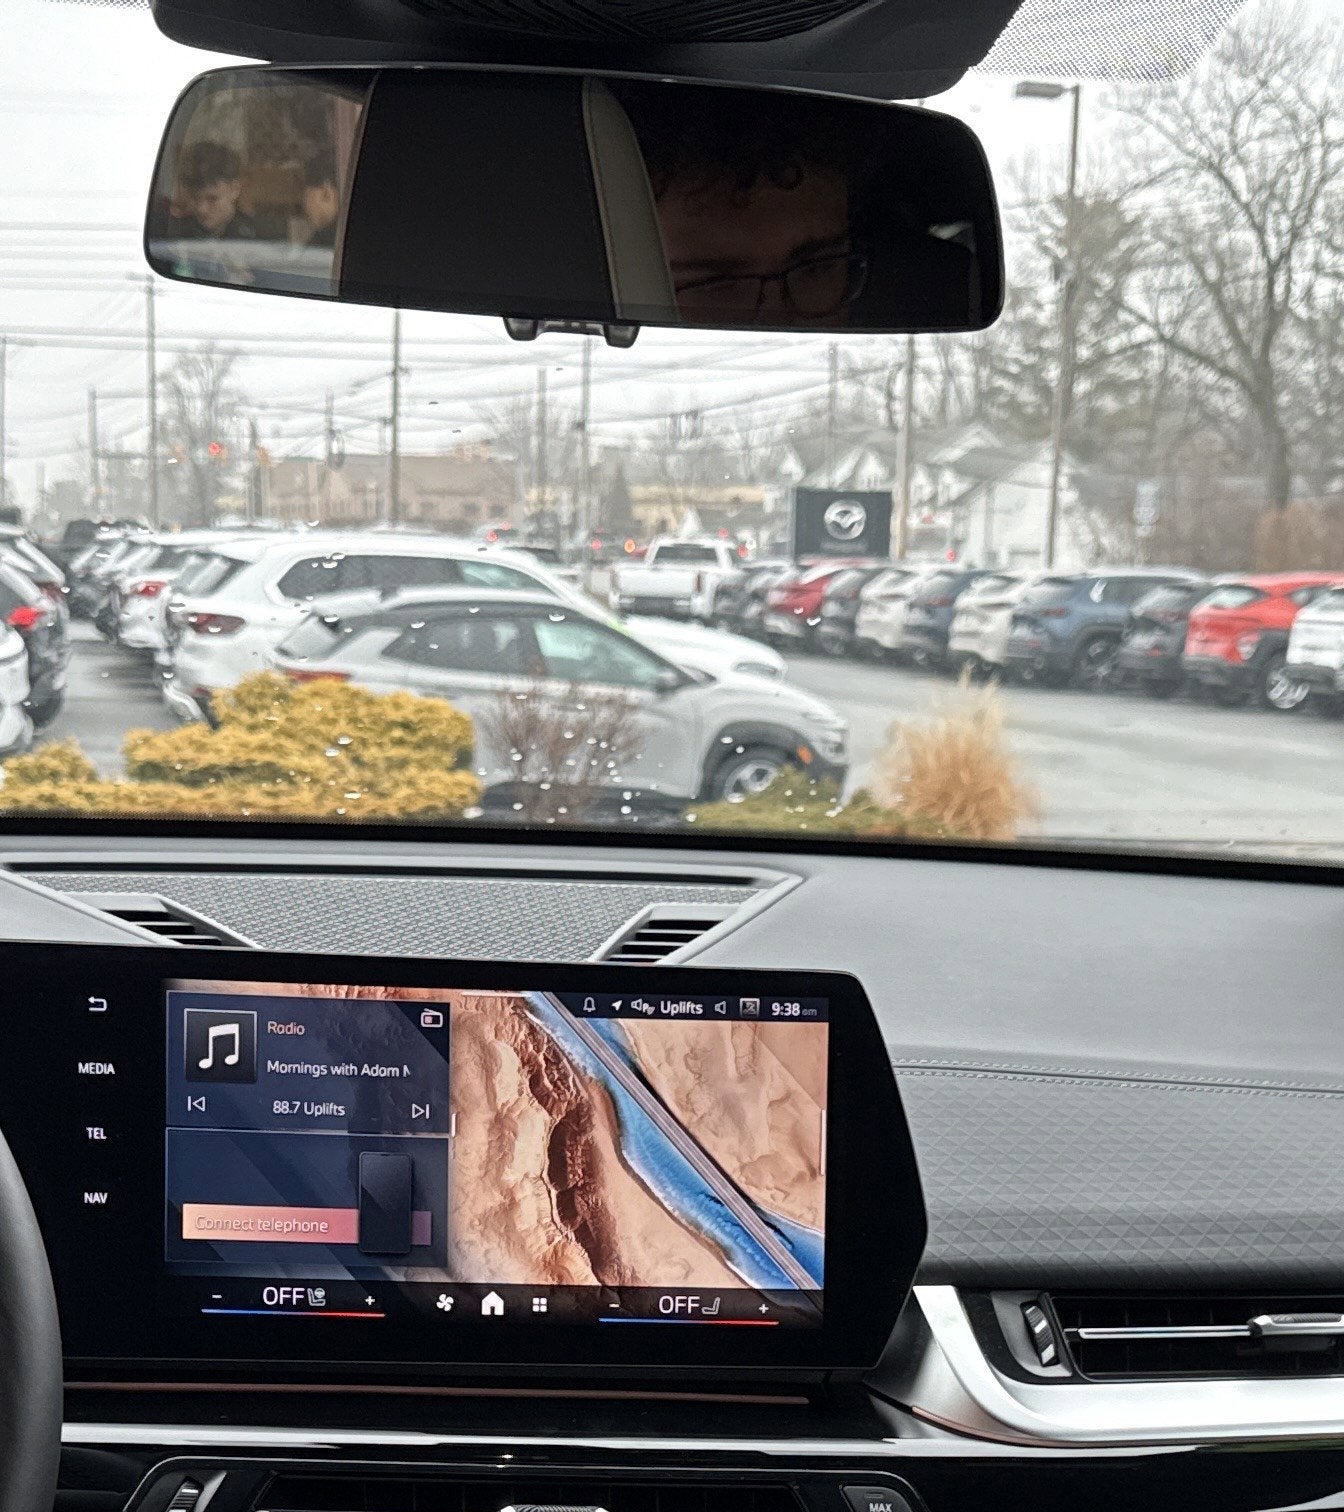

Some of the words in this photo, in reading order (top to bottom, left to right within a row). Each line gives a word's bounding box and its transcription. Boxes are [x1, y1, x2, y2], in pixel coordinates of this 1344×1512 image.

[660, 1000, 703, 1016] Uplifts
[771, 1002, 800, 1016] 9:38
[267, 1021, 305, 1036] Radio
[78, 1062, 115, 1074] MEDIA
[267, 1060, 328, 1078] Mornings
[331, 1062, 357, 1077] with
[360, 1064, 400, 1078] Adam
[273, 1101, 301, 1115] 88.7
[304, 1102, 345, 1117] Uplifts
[86, 1127, 107, 1139] TEL
[84, 1192, 108, 1203] NAV
[195, 1215, 254, 1231] Connect
[258, 1218, 329, 1234] telephone
[262, 1286, 305, 1305] OFF
[659, 1296, 700, 1314] OFF
[869, 1502, 892, 1512] MAX
